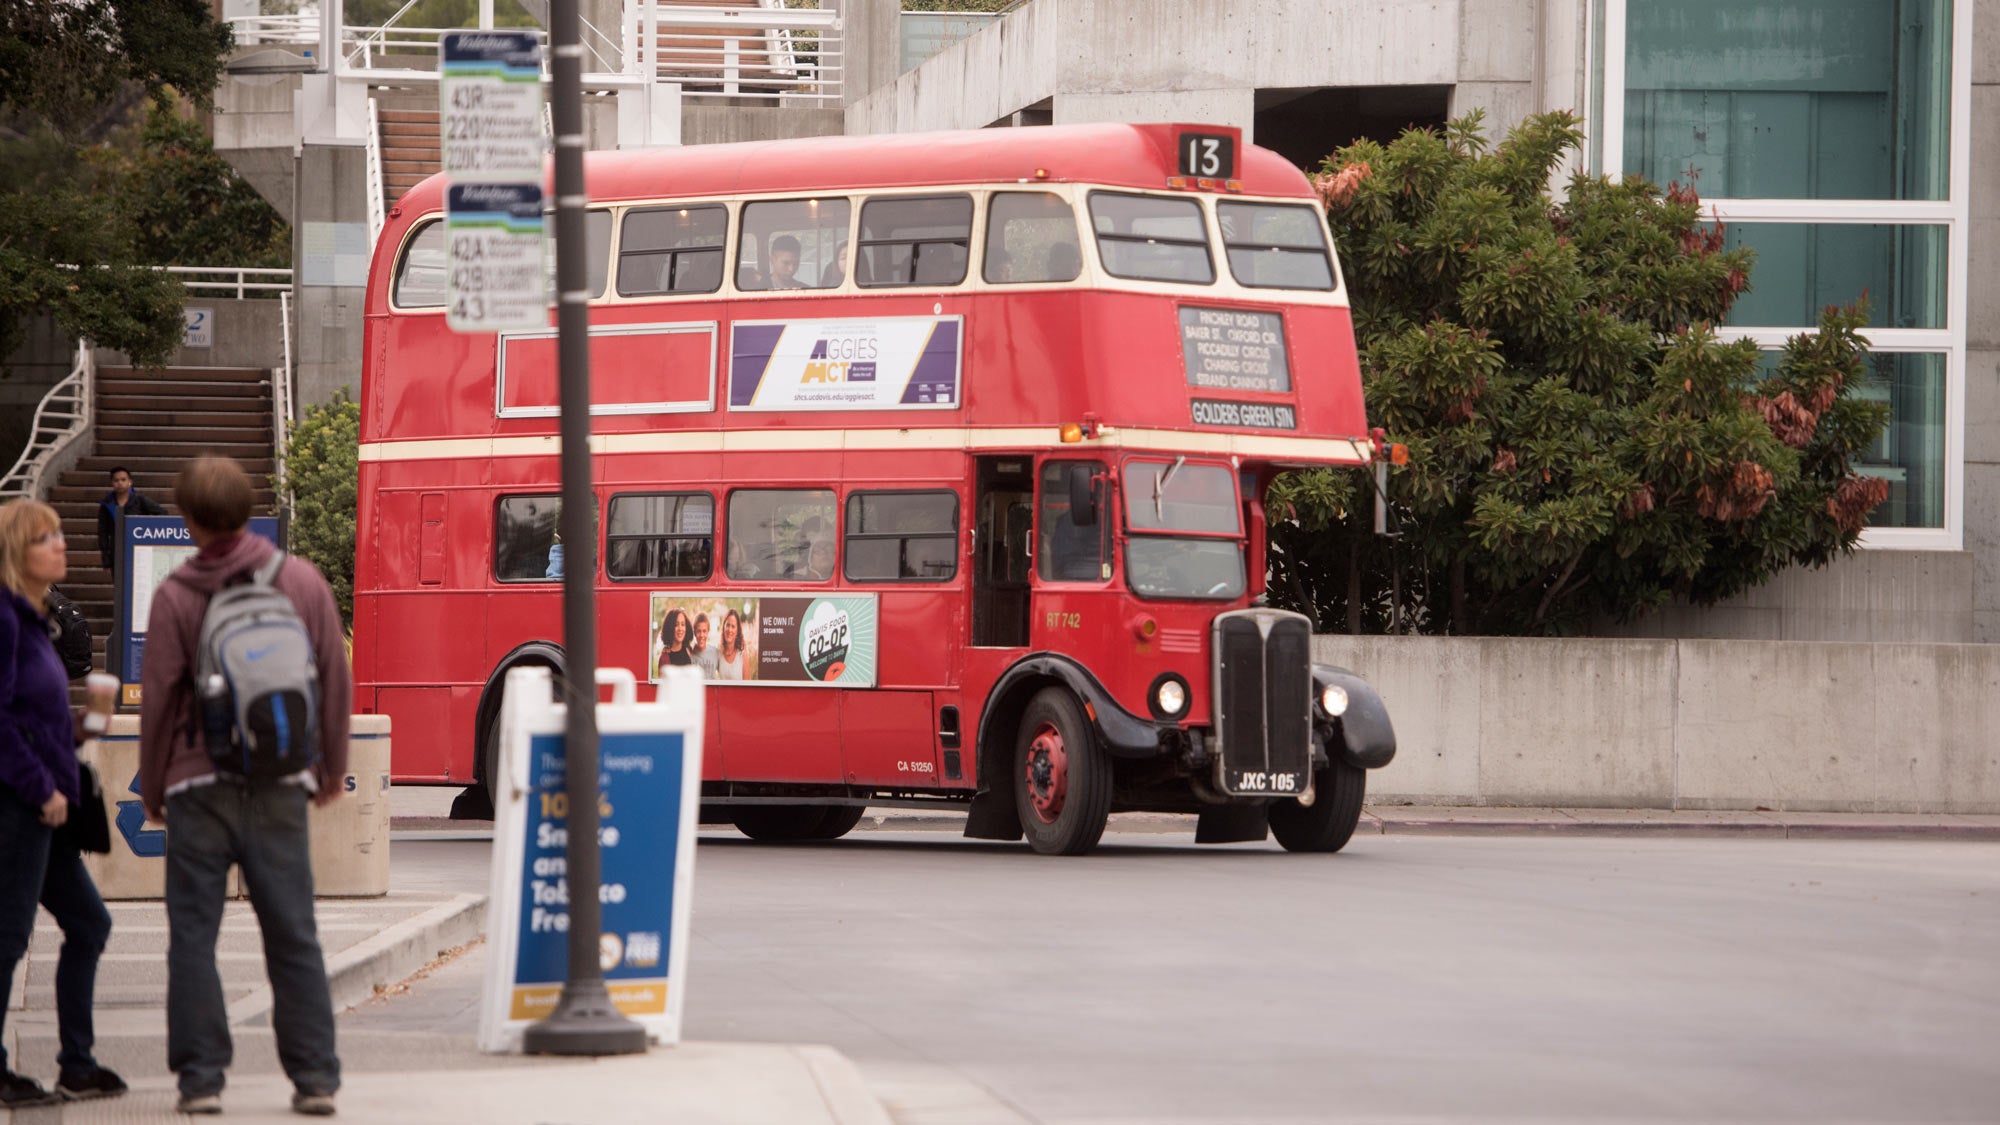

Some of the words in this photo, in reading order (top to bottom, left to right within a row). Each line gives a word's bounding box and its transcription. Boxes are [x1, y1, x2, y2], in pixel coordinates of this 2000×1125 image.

[451, 85, 482, 109] 43R
[1190, 138, 1219, 176] 13
[450, 236, 482, 260] 42A
[452, 298, 484, 320] 43
[1235, 314, 1260, 328] ROAD
[1185, 325, 1210, 339] BAKER
[1227, 329, 1261, 344] OXFORD
[810, 338, 878, 360] AGGIES
[1197, 342, 1240, 357] PICCADILLY
[1241, 345, 1271, 360] CIRCUS
[1203, 358, 1241, 373] CHARING
[1242, 361, 1269, 375] CROSS
[1196, 373, 1228, 387] STRAND
[1192, 402, 1240, 424] GOLDERS
[1240, 404, 1275, 427] GREEN
[1274, 406, 1295, 429] STN
[133, 526, 191, 540] CAMPUS
[762, 616, 773, 626] WE
[773, 616, 787, 626] OWN
[809, 622, 828, 638] DAVIS
[828, 615, 847, 629] FOOD
[1046, 613, 1060, 628] RT
[1061, 613, 1081, 628] 742
[808, 624, 848, 658] CO-OP
[809, 655, 828, 670] WELCOME
[897, 760, 909, 772] CA
[911, 761, 933, 773] 51250
[1239, 771, 1266, 791] JXC
[1269, 772, 1295, 791] 105
